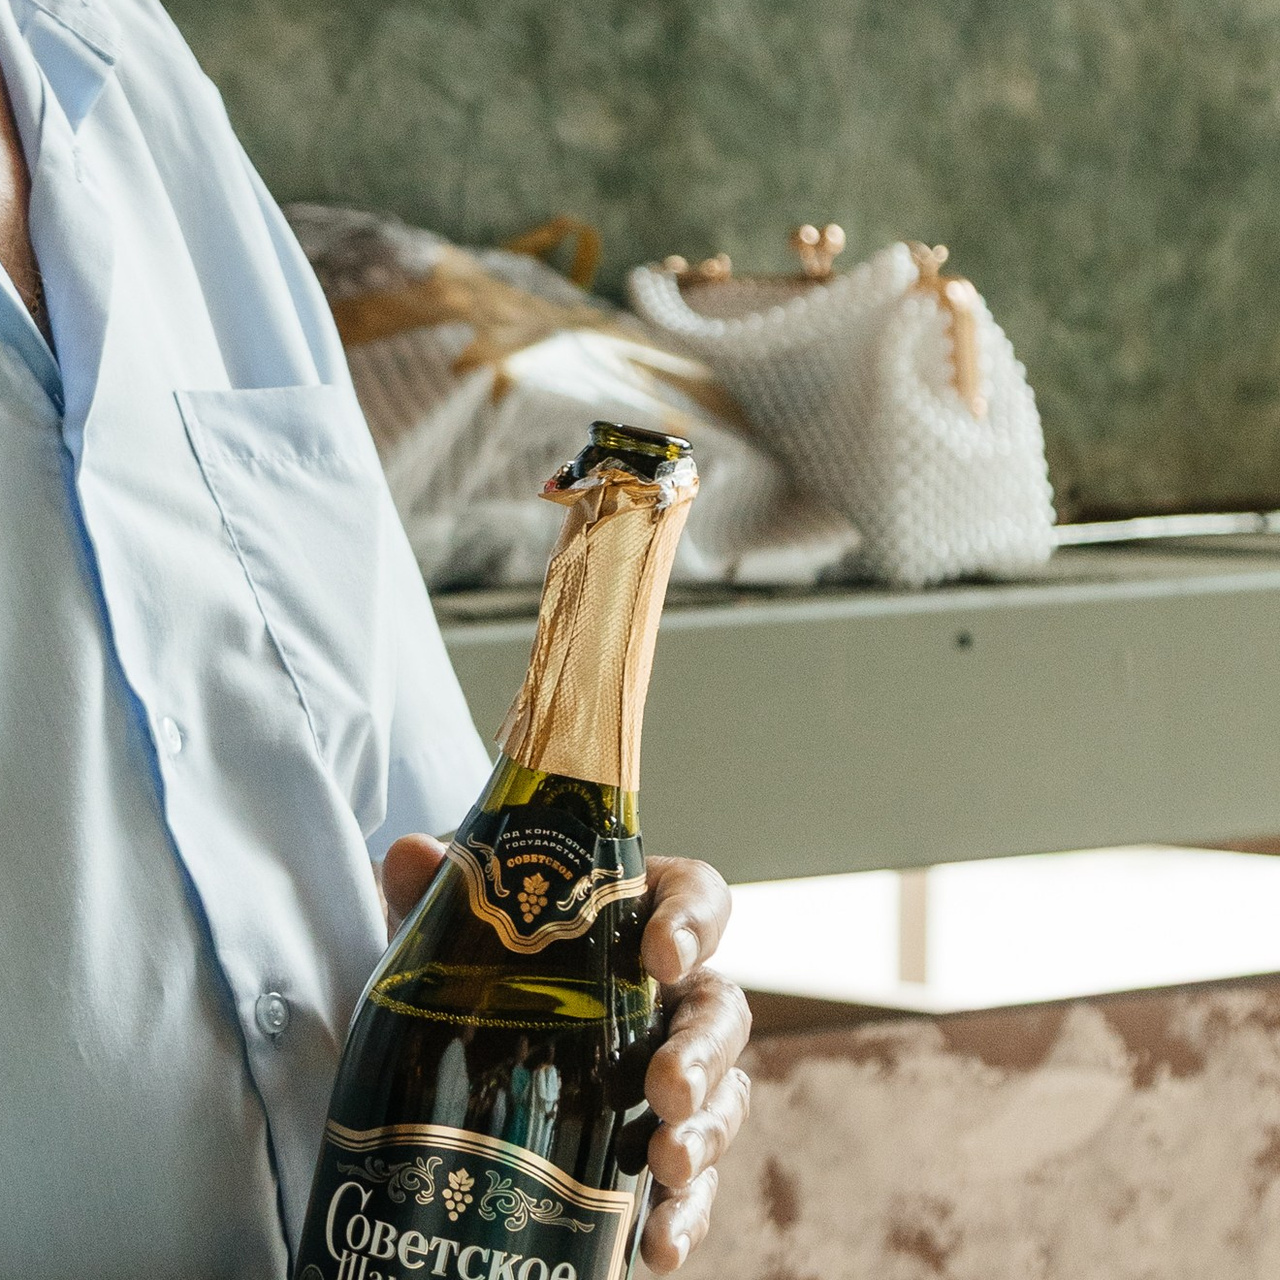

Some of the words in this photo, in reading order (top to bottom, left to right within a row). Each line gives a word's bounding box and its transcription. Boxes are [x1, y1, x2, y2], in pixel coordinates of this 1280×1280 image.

[505, 839, 581, 865] ГОСУДАРСТВА
[525, 828, 595, 863] КОНТРОЛЕМ
[506, 854, 573, 880] СОВЕТСКОЕ
